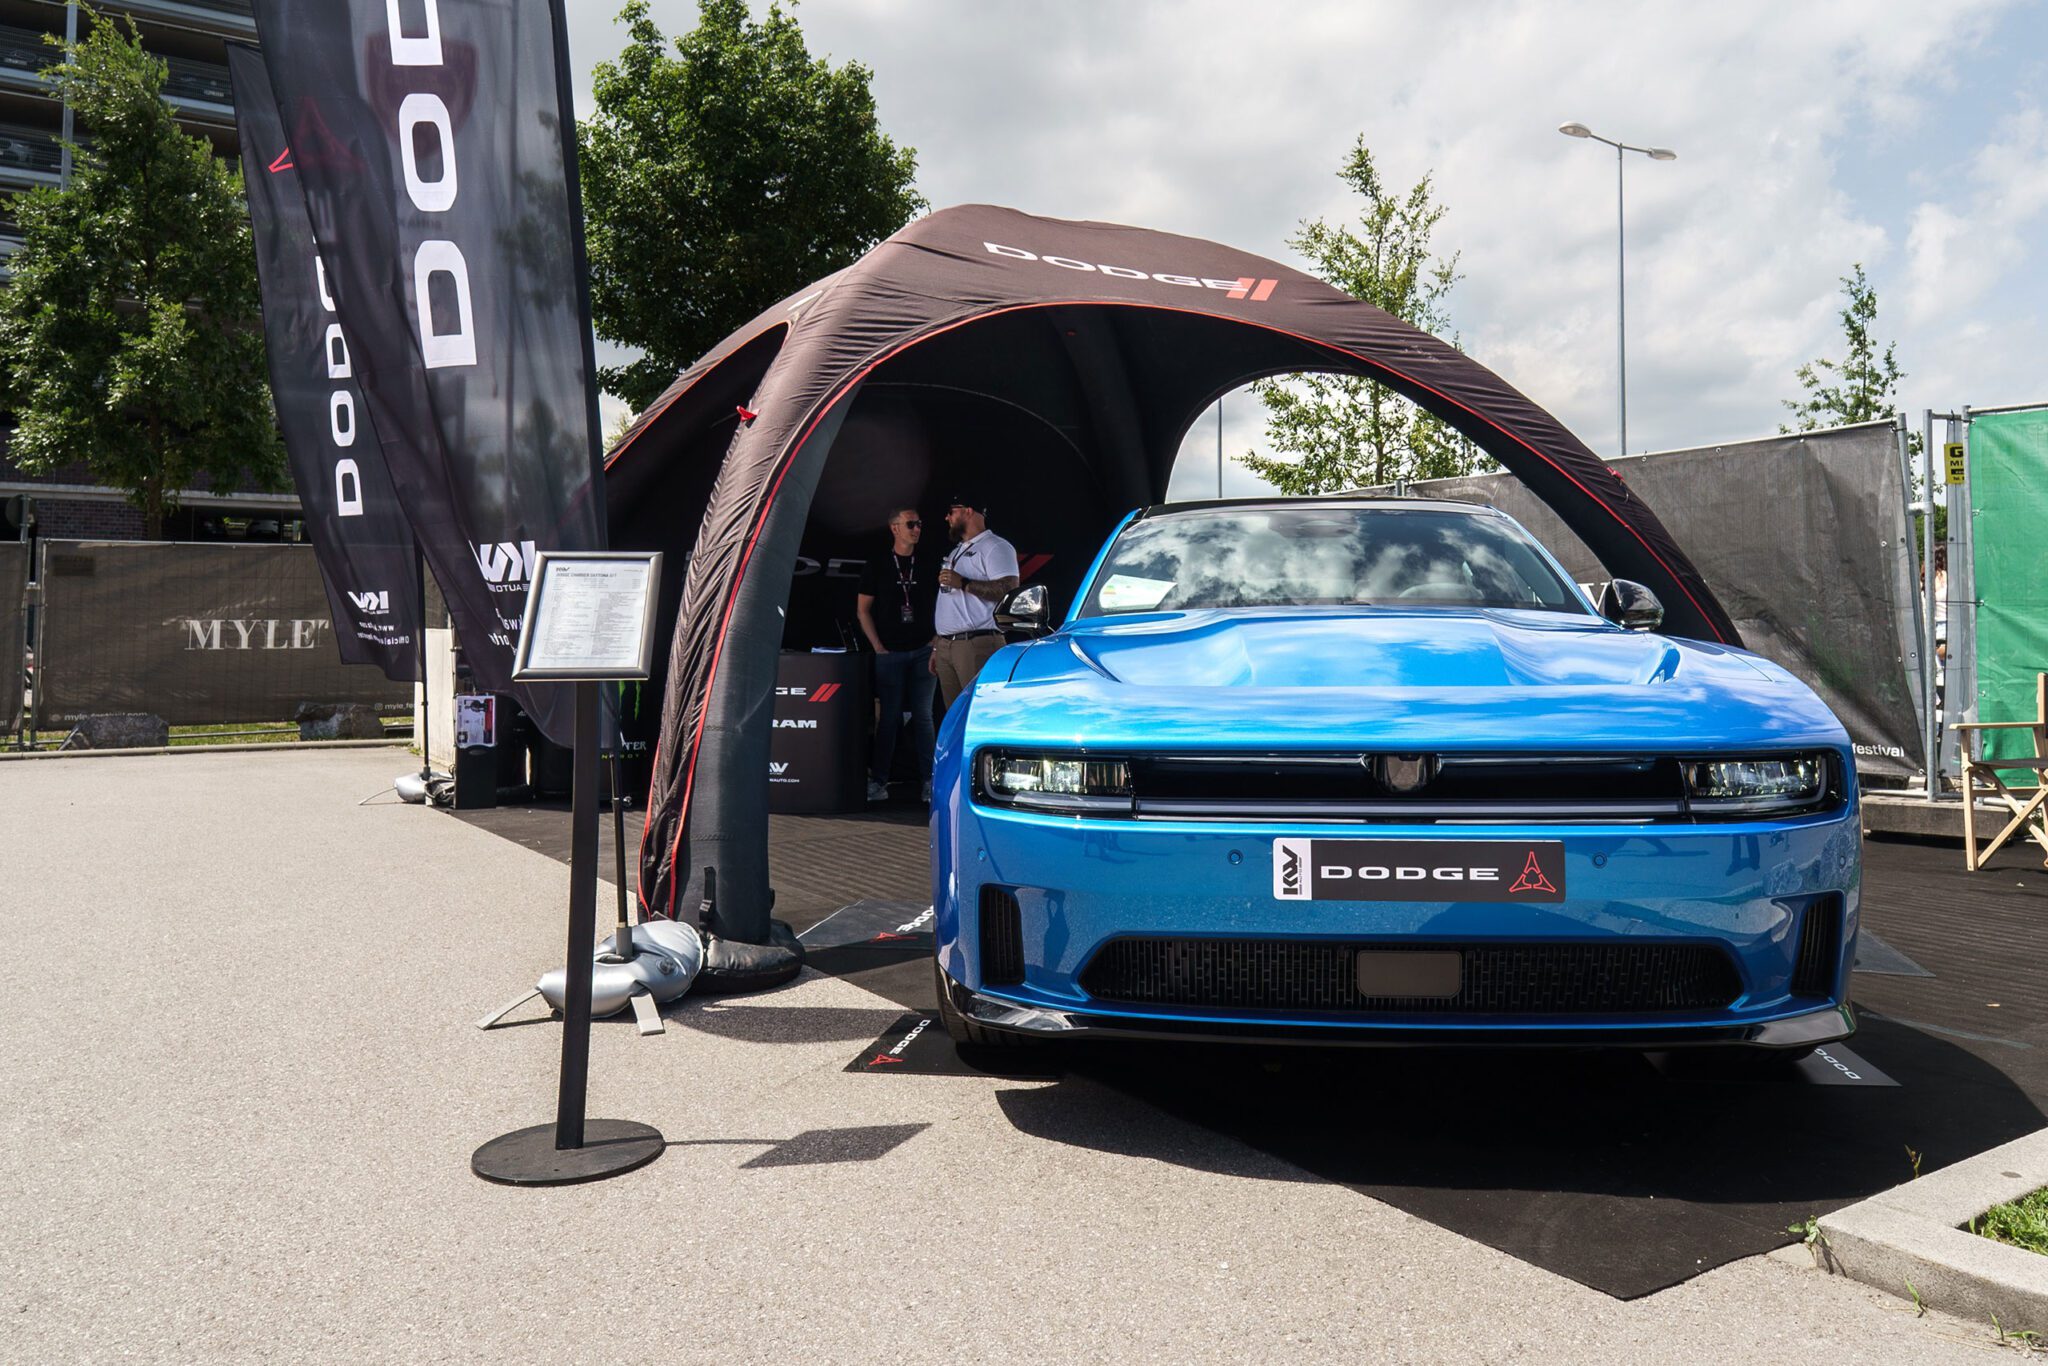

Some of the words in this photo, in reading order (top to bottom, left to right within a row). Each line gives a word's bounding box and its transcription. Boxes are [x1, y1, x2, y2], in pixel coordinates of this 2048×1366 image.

[983, 241, 1250, 292] DODGE
[1950, 446, 1963, 458] G
[1320, 865, 1500, 881] DODGE
[889, 1019, 932, 1055] DODGE
[1814, 1048, 1862, 1080] DODG
